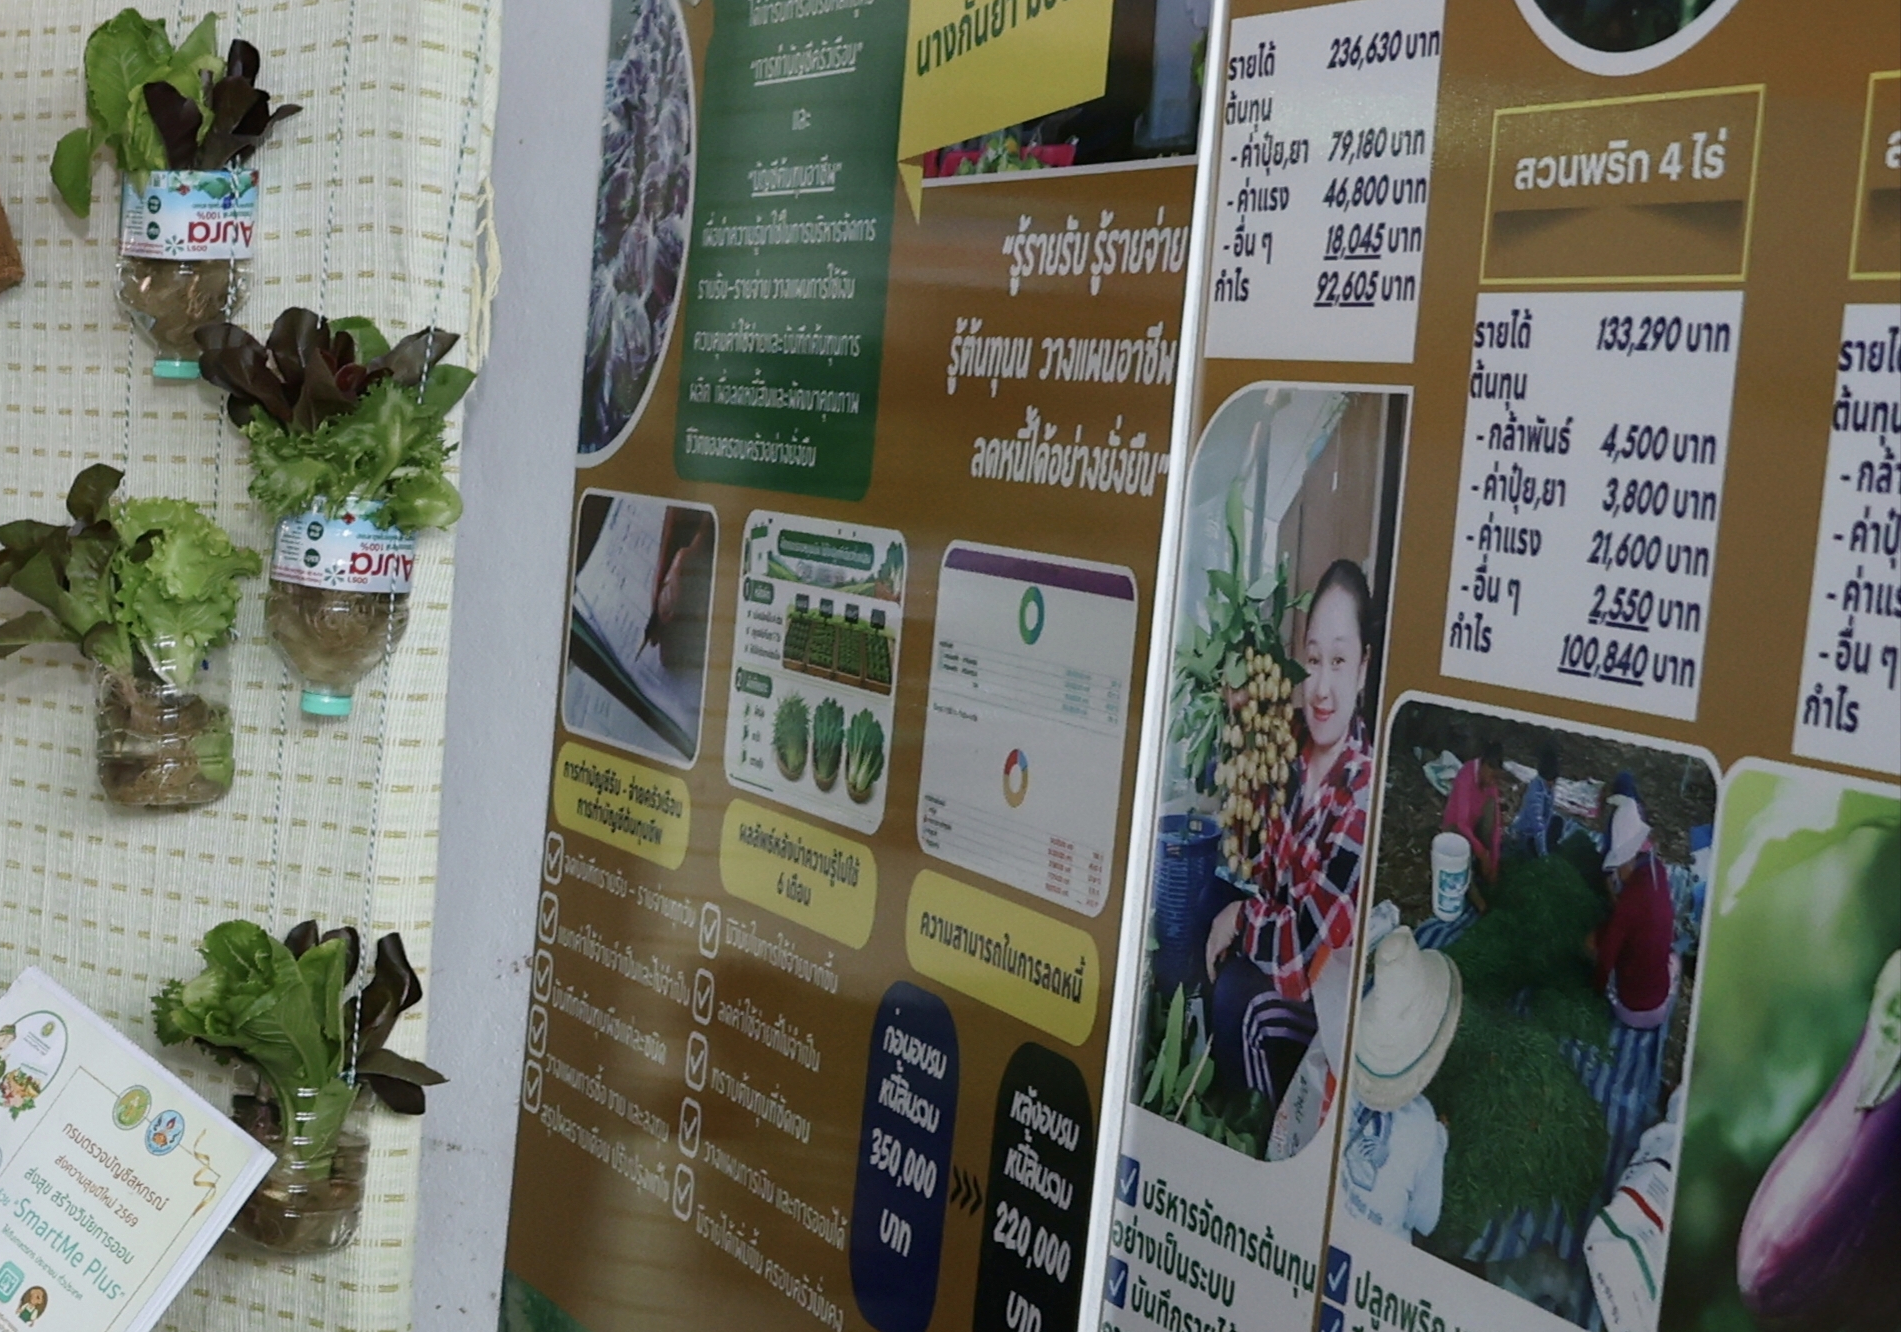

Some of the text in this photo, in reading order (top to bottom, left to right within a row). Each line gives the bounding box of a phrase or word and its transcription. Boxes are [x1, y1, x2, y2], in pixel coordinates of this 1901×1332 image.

[1228, 26, 1440, 81] รายได้ 236,630 บาท
[1225, 91, 1272, 134] ต้นทุน
[1328, 126, 1387, 164] 79,180
[1390, 125, 1425, 158] บาท
[1513, 127, 1727, 191] สวนพริก 4 ไร่
[1237, 172, 1427, 217] ค่าแรง 46,800 บาท
[1324, 221, 1383, 260] 18,045
[1386, 223, 1423, 254] บาท
[1214, 269, 1416, 307] กำไร 92,605 บาท
[1039, 321, 1177, 386] วางแผนอาชีพ
[1474, 308, 1732, 356] รายได้ 133,290 บาท
[1470, 365, 1528, 409] ต้นทุน
[1600, 423, 1669, 464] 4,500
[1672, 431, 1717, 466] บาท
[1601, 477, 1670, 519] 3,800
[1673, 486, 1717, 523] บาท
[1478, 514, 1710, 577] ค่าแรง 21,600 บาท
[1588, 585, 1653, 631] 2,550
[1657, 594, 1701, 633] บาท
[1449, 612, 1696, 690] กำไร 100,840 บาท
[1802, 681, 1860, 733] กำไร
[61, 1121, 170, 1212] กรมตรวจบัญชีสหกรณ์
[870, 1128, 938, 1200] 350,000
[23, 1167, 135, 1266] ส่งสุข สร้างวินัยการออม
[54, 1154, 139, 1228] ส่งความสุขปีใหม่ 2569
[879, 1207, 912, 1258] บาท
[994, 1201, 1071, 1284] 220,000
[1142, 1177, 1316, 1299] บริหารจัดการต้นทุน
[1111, 1216, 1235, 1308] อย่างเป็นระบบ
